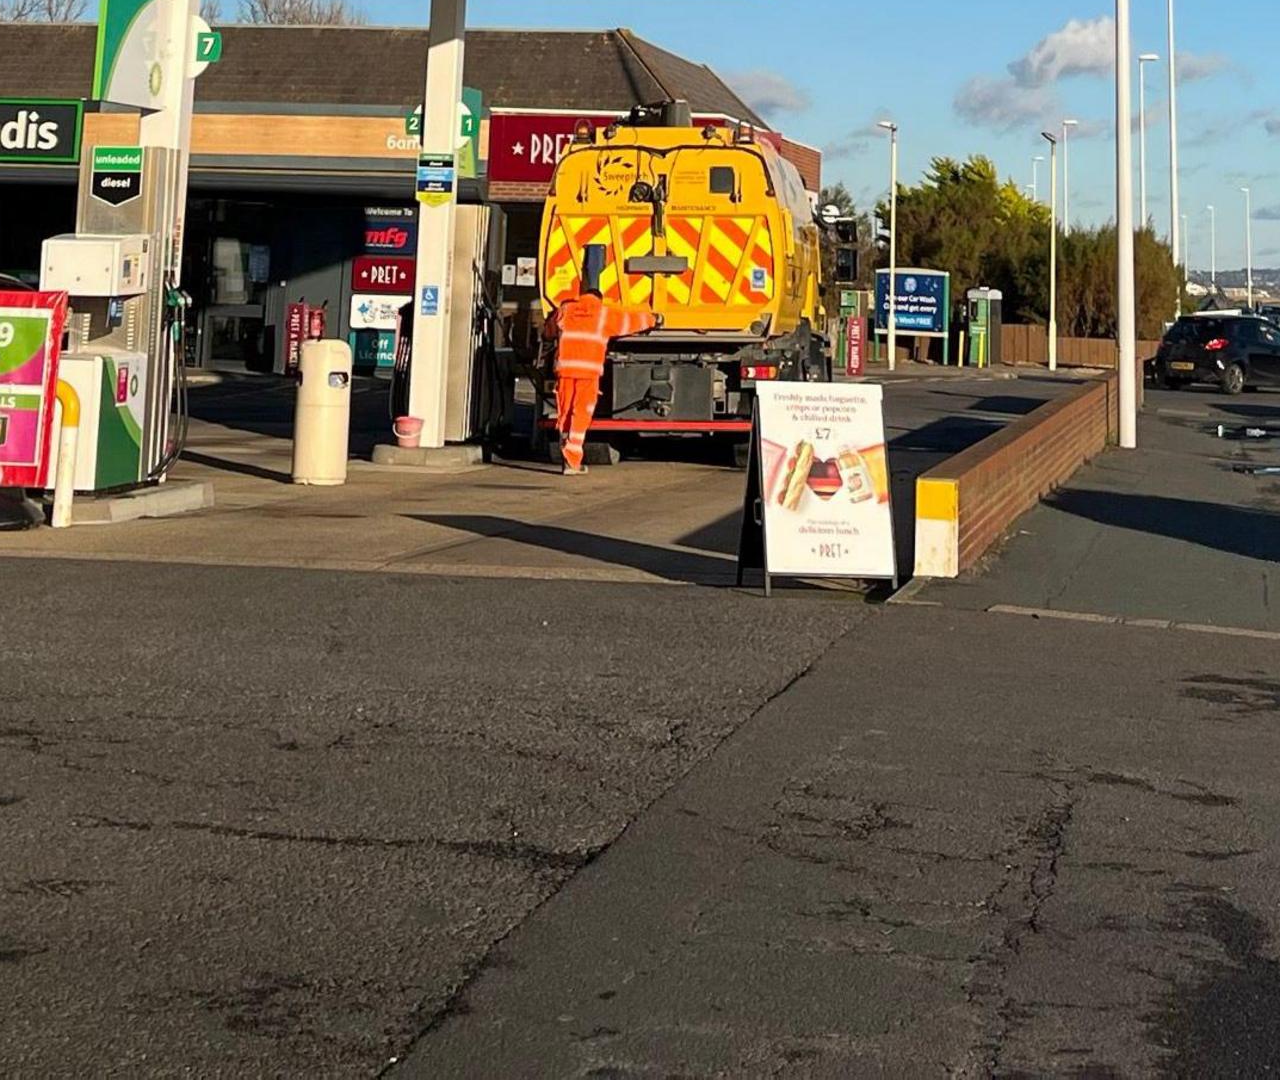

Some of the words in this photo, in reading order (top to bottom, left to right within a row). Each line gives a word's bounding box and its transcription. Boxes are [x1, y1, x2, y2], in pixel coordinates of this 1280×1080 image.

[202, 36, 216, 56] 7
[408, 117, 419, 131] 2
[464, 118, 473, 132] 1
[95, 153, 141, 166] unleaded
[100, 176, 131, 189] diesel
[403, 207, 413, 217] To
[365, 227, 408, 248] mfg
[370, 265, 399, 285] PRET
[815, 428, 832, 440] £7
[819, 543, 842, 558] PRET
